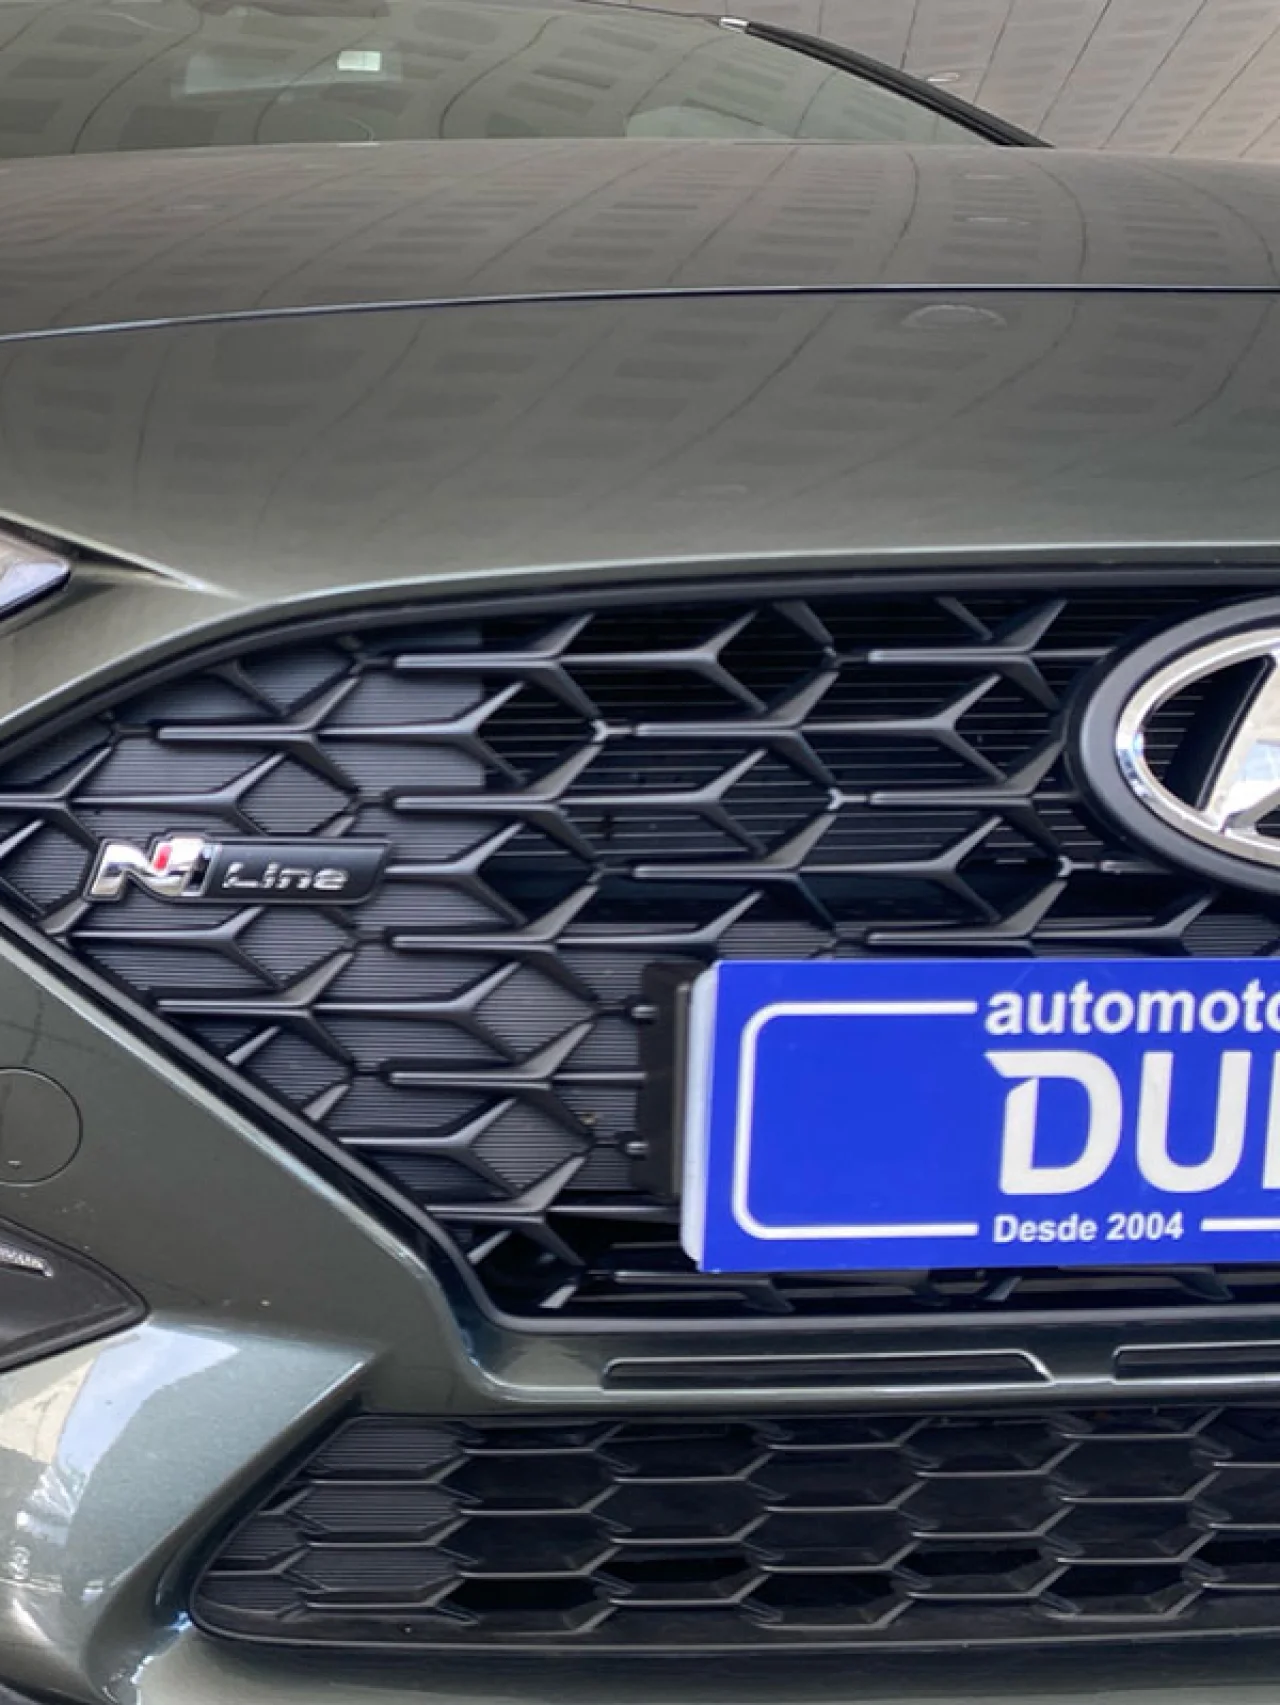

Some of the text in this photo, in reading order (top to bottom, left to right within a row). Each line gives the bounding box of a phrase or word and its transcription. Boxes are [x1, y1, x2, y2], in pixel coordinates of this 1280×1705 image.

[222, 862, 348, 890] Line
[984, 1050, 1280, 1194] DU
[992, 1210, 1185, 1243] Desde 2004
